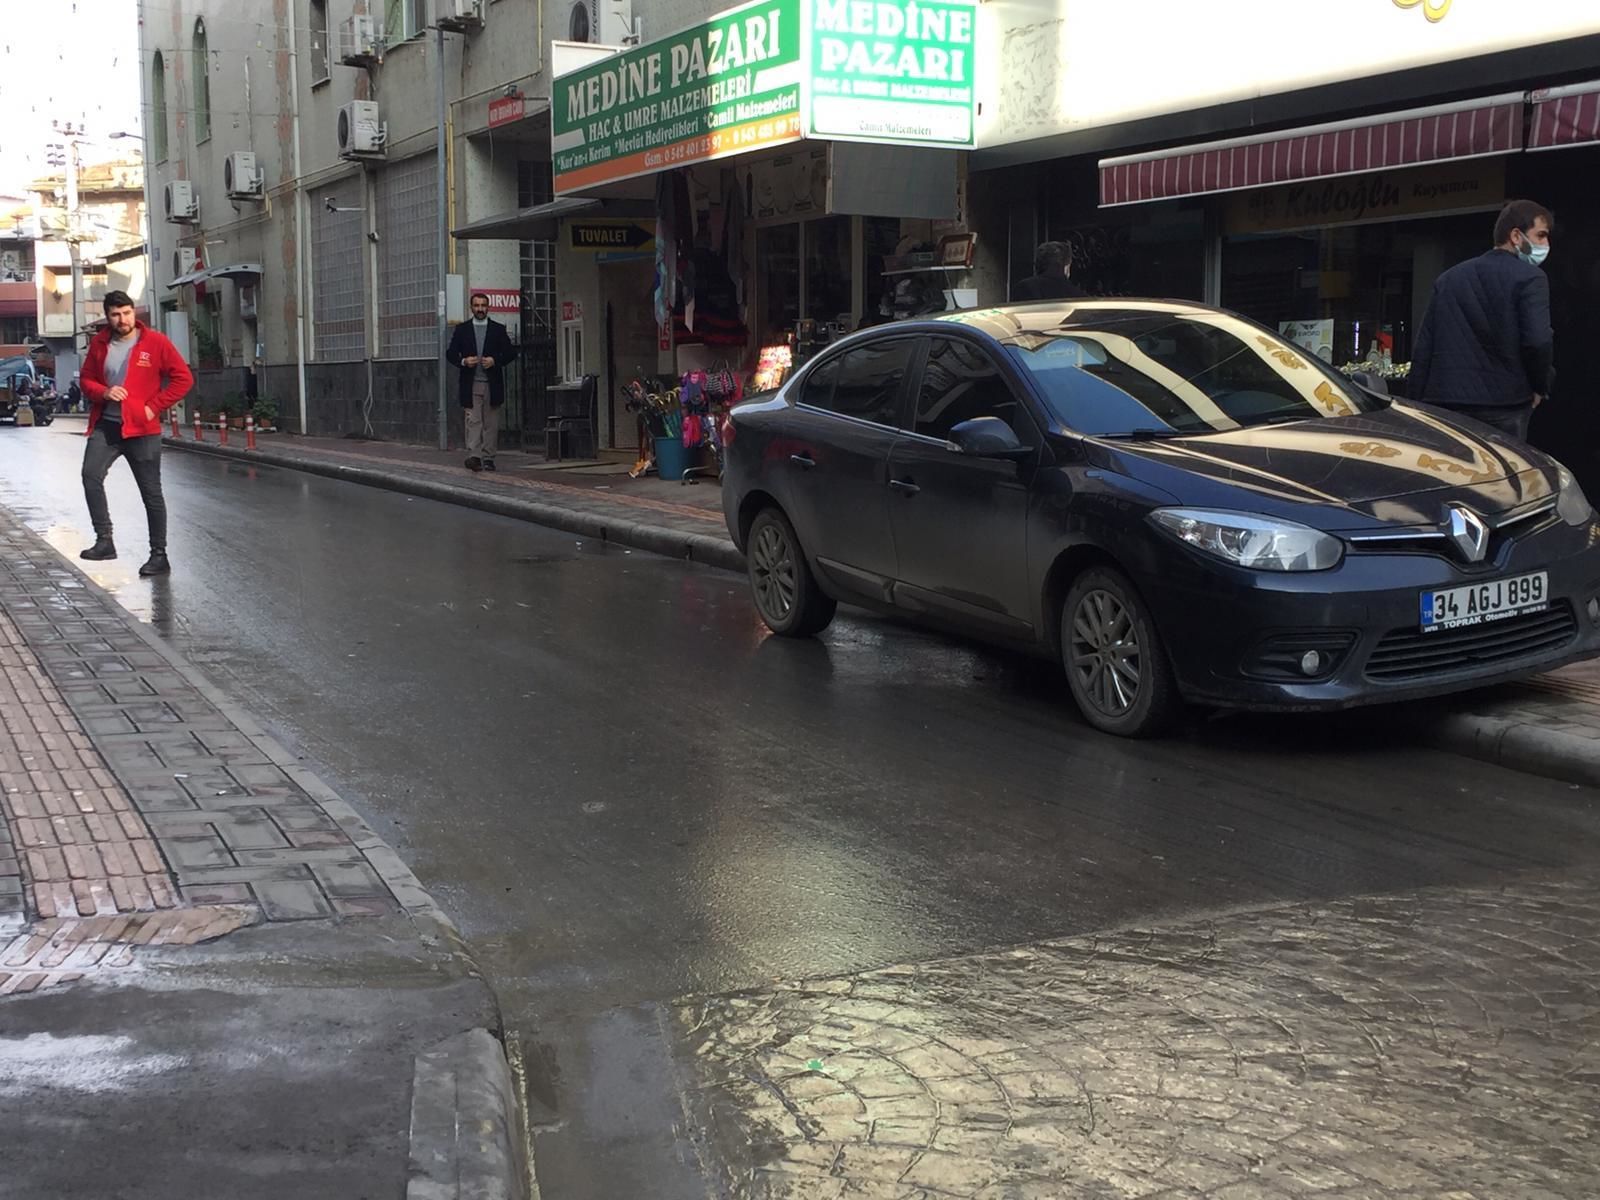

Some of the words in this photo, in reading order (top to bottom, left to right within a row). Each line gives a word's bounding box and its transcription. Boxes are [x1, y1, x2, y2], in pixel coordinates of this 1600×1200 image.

[815, 0, 971, 43] MEDİNE
[566, 53, 662, 123] MEDİNE
[670, 8, 781, 88] PAZARI
[820, 38, 965, 81] PAZARI
[588, 118, 611, 143] HAC
[612, 115, 622, 134] &
[624, 105, 658, 132] UMRE
[660, 69, 752, 120] MALZEMELERİ
[588, 143, 611, 164] Kerim
[579, 229, 628, 243] TUVALET
[1434, 592, 1459, 620] 34
[1467, 583, 1502, 615] AGJ
[1508, 575, 1543, 606] 899
[1443, 616, 1482, 629] TOPRAK
[1485, 609, 1518, 622] Otomotiv
